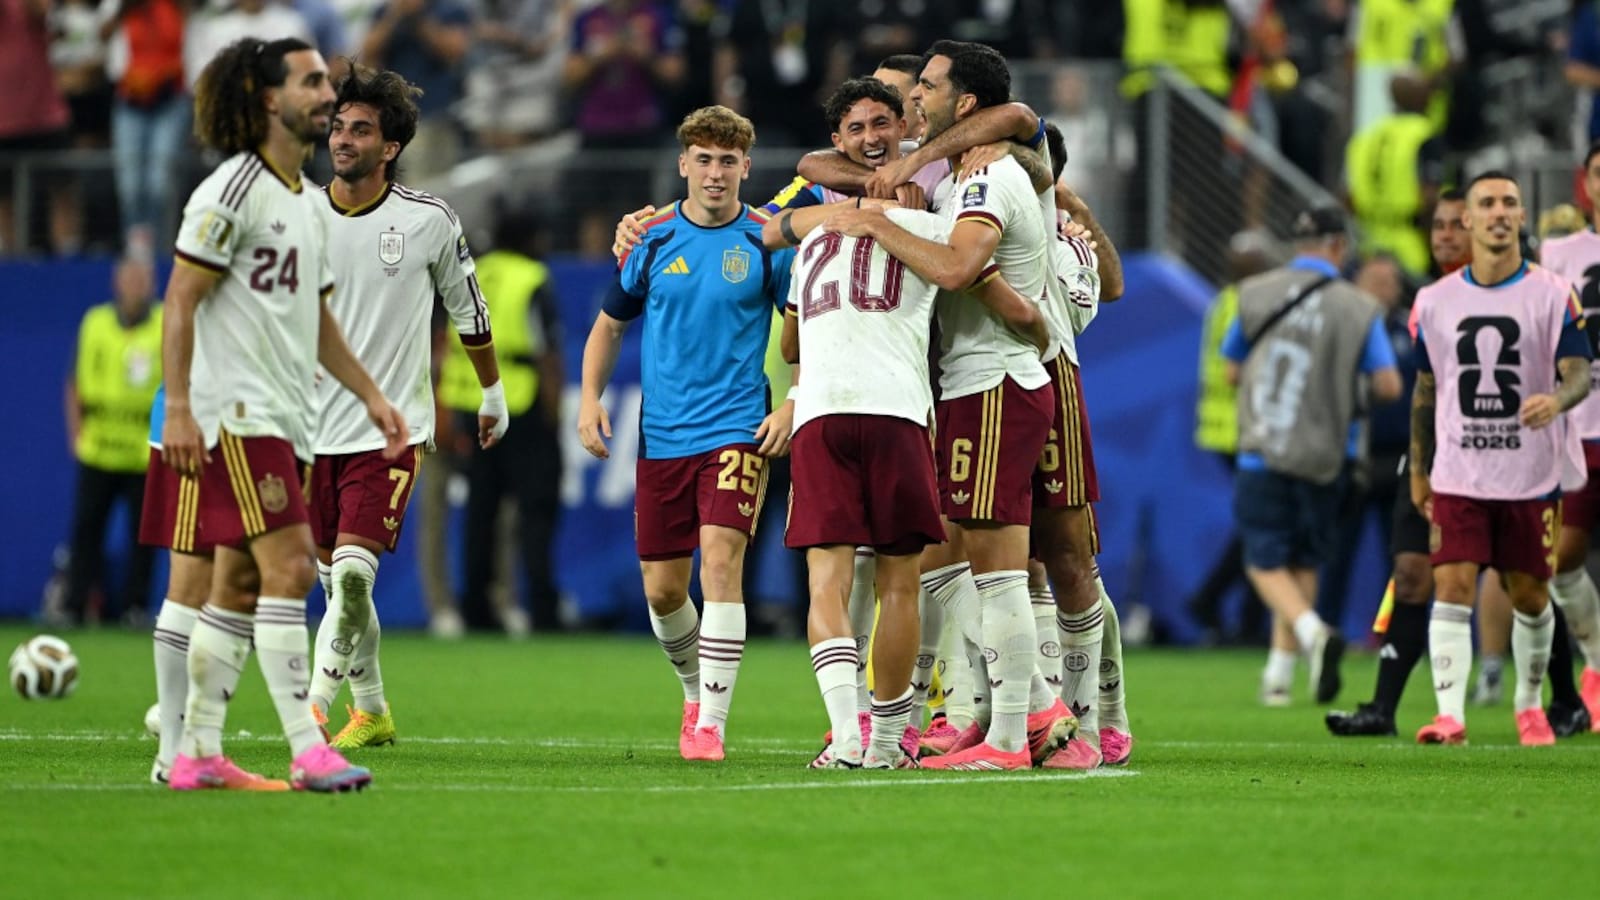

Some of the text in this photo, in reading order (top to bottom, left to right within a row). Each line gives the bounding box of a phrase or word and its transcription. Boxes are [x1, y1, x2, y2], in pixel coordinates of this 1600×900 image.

[250, 246, 299, 294] 24
[802, 231, 905, 324] 20
[1474, 398, 1504, 411] FIFA
[950, 438, 972, 482] 6
[1461, 436, 1521, 450] 2026
[389, 468, 410, 510] 7
[717, 450, 763, 495] 25
